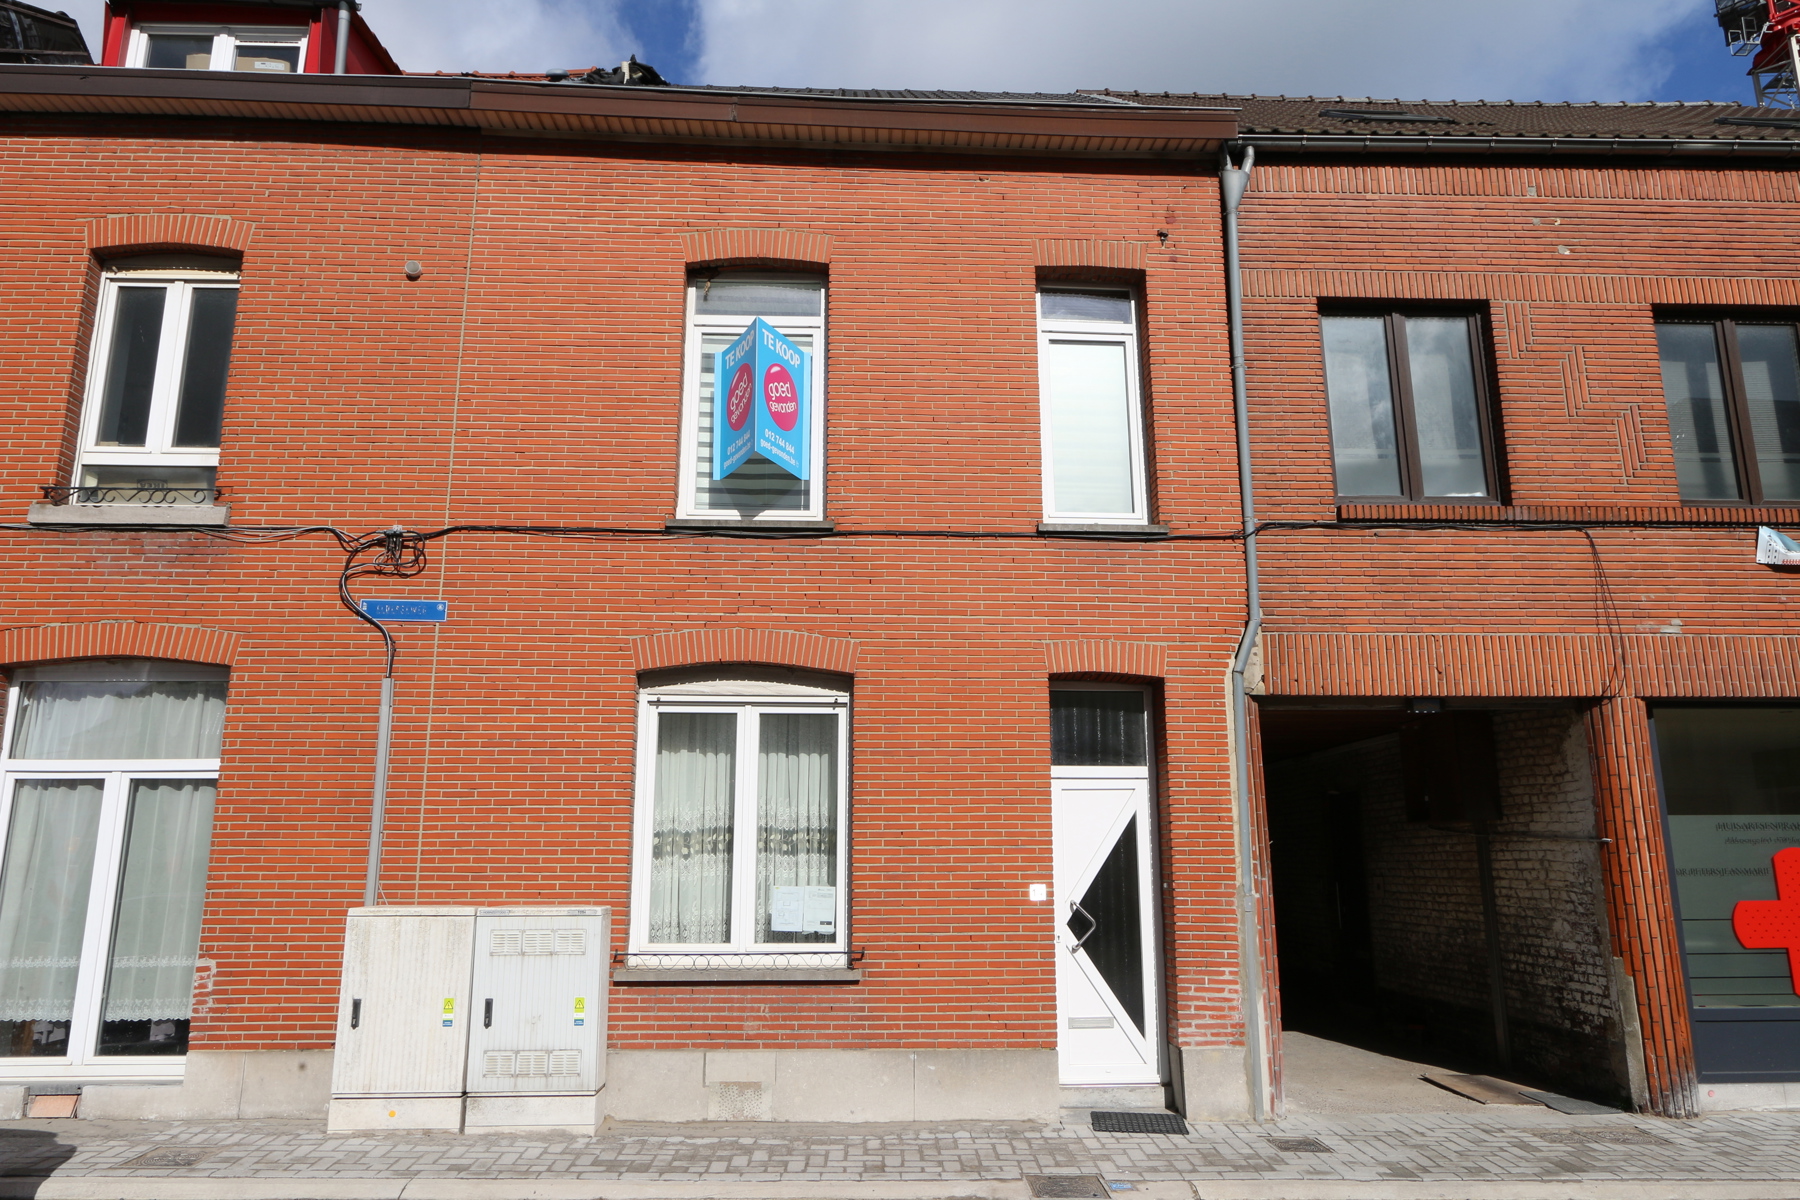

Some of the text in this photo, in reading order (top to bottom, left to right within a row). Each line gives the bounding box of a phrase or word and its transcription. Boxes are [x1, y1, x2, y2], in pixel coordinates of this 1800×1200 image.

[725, 330, 754, 369] TE KOOP
[762, 328, 801, 369] TE KOOP
[730, 372, 748, 412] goed
[768, 381, 791, 400] goed
[769, 401, 797, 413] gevonden
[765, 428, 775, 442] 012
[775, 435, 785, 448] 744
